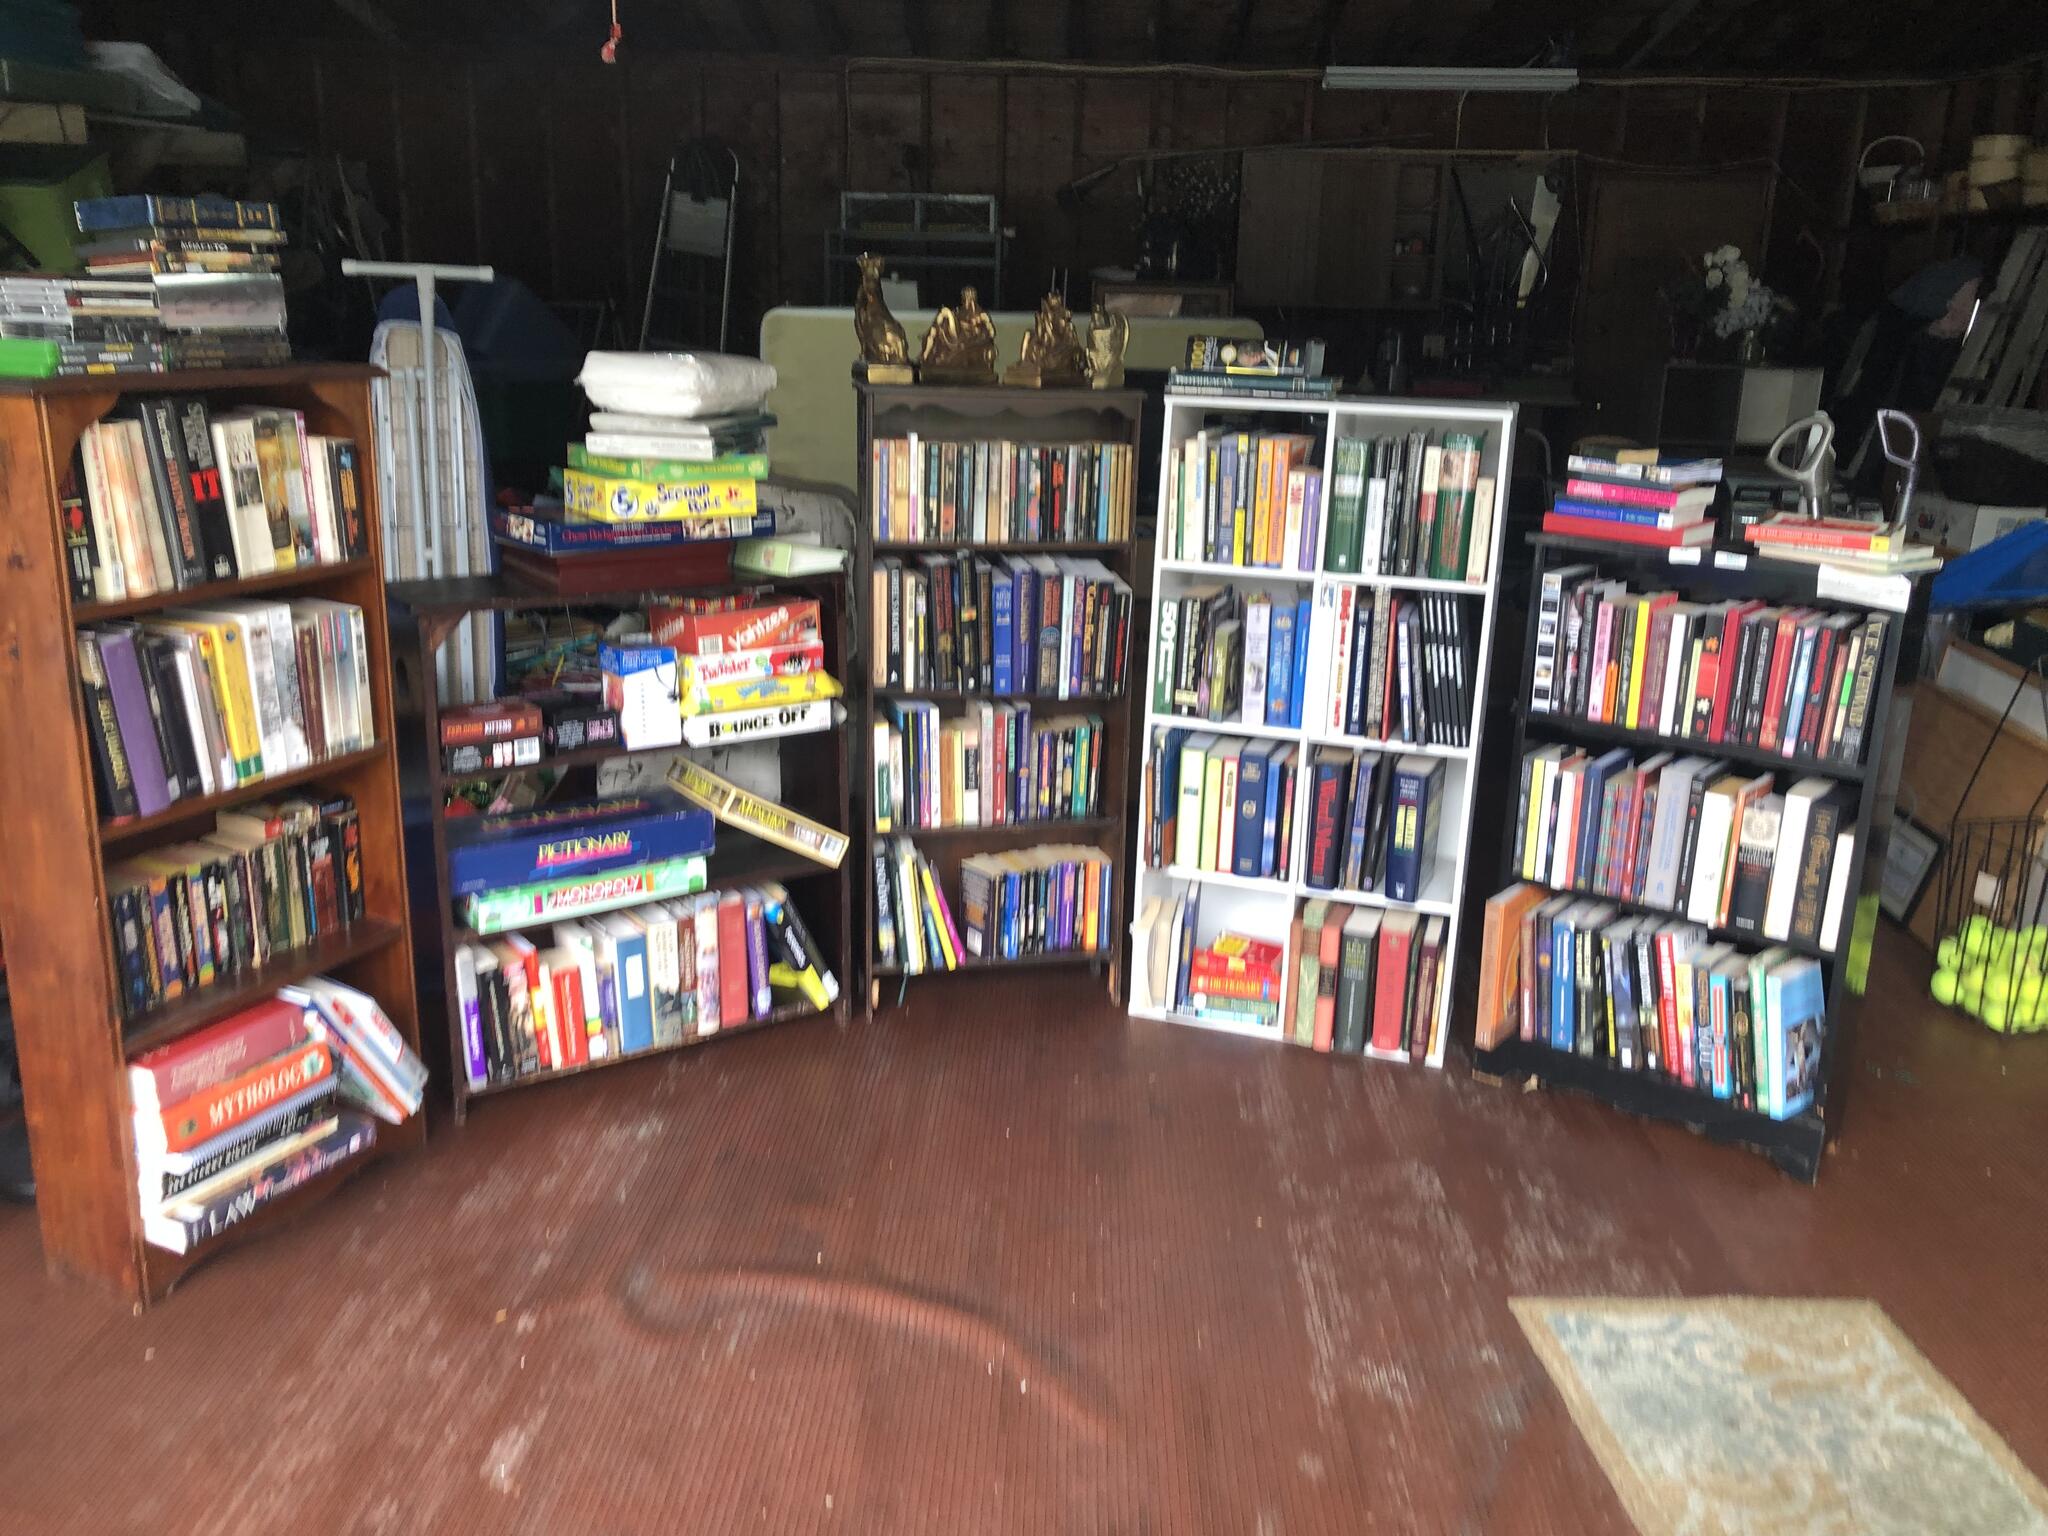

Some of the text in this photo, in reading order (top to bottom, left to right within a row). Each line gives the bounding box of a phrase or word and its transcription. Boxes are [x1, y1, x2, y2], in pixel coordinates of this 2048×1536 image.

[190, 468, 221, 503] IT
[778, 704, 812, 726] OFF
[538, 829, 633, 862] PICTIONARY
[556, 873, 641, 910] MONOPOLY
